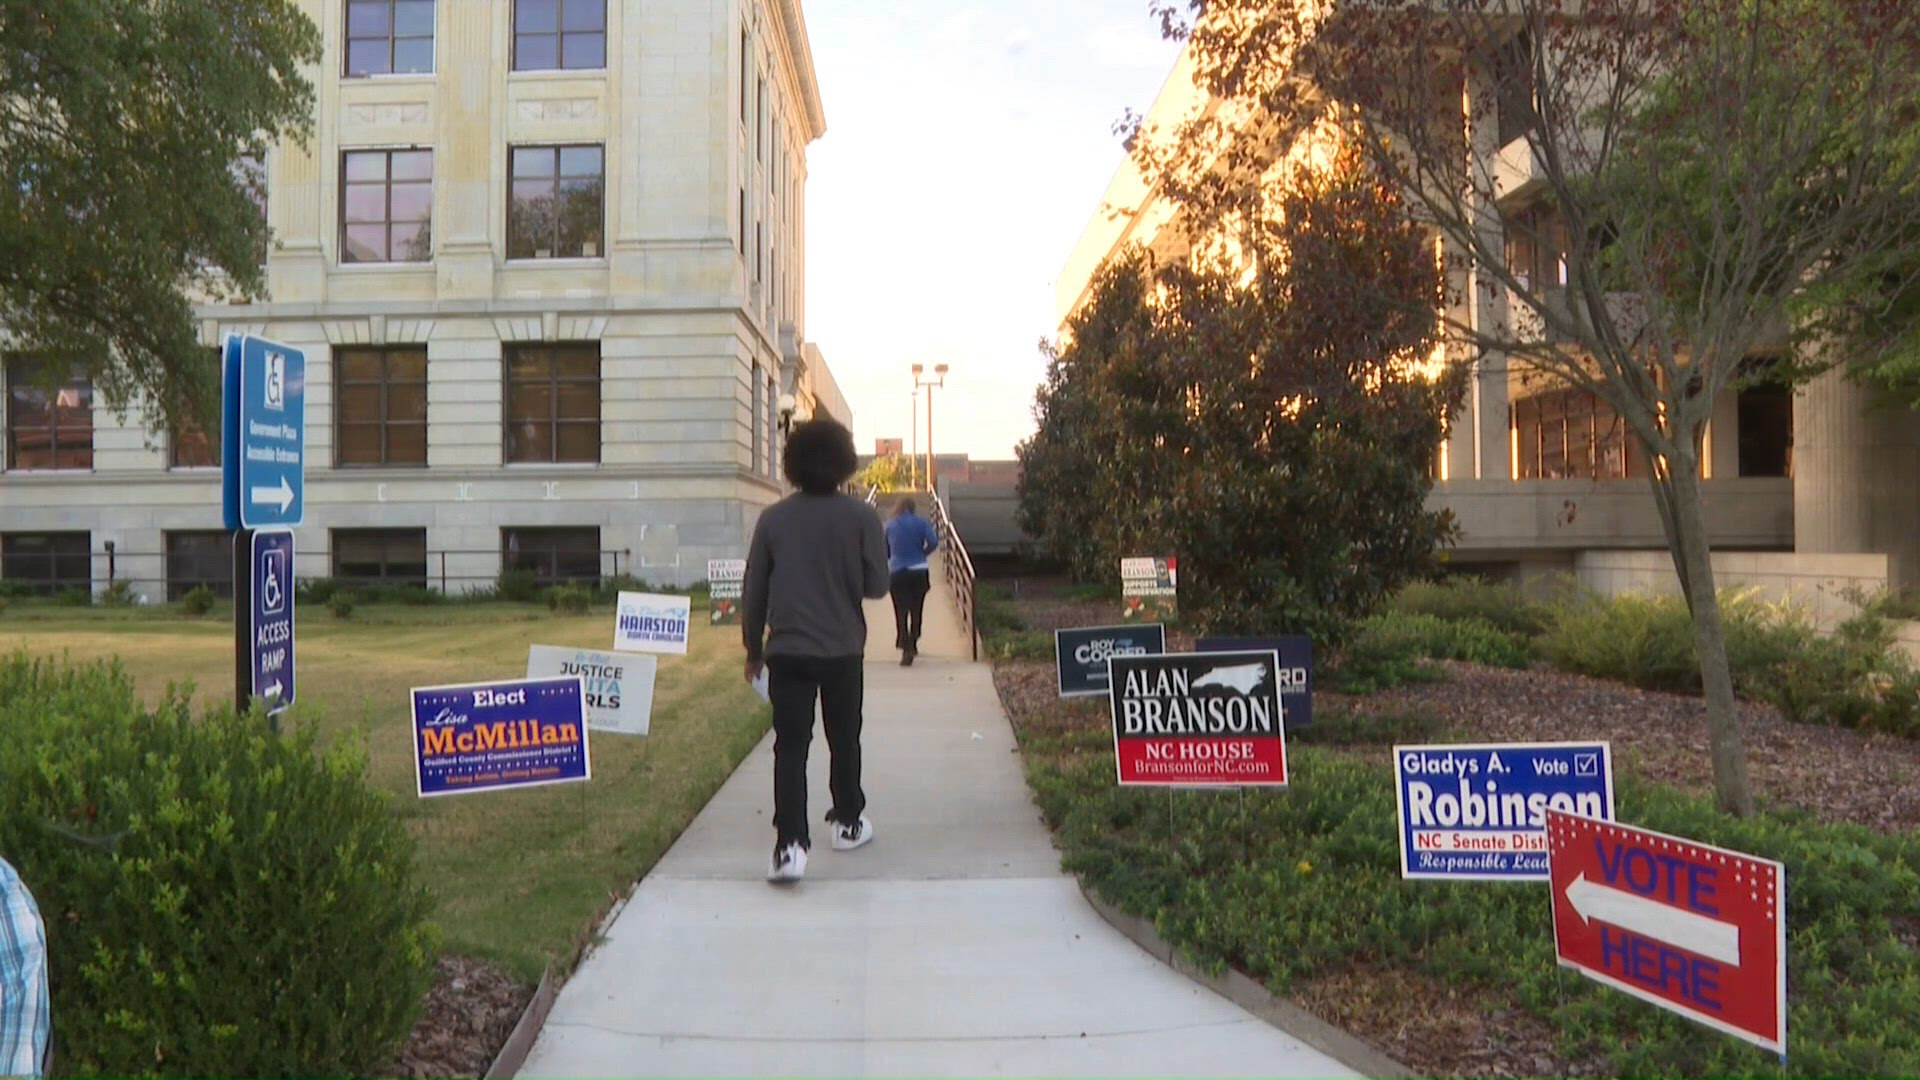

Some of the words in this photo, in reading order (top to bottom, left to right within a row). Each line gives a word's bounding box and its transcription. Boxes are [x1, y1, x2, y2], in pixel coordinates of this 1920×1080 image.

[257, 620, 289, 648] ACCESS
[619, 614, 685, 634] HAIRSTON
[1090, 639, 1115, 650] ROY
[261, 648, 286, 674] RAMP
[560, 661, 624, 680] JUSTICE
[1123, 668, 1189, 697] ALAN
[472, 688, 526, 708] Elect
[584, 693, 621, 709] RLS
[425, 707, 469, 727] Lisa
[1122, 696, 1271, 734] BRANSON
[421, 719, 579, 757] McMillan
[1145, 742, 1175, 760] NC
[1179, 741, 1255, 760] HOUSE
[1135, 758, 1270, 775] BransonforNC.com
[1403, 752, 1479, 779] Gladys
[1486, 751, 1511, 774] A.
[1532, 758, 1569, 775] Vote
[1408, 777, 1601, 827] Robinson
[1417, 833, 1443, 849] NC
[1452, 833, 1506, 849] Senate
[1512, 833, 1547, 849] Dist
[1418, 852, 1508, 873] Responsible
[1594, 838, 1720, 917] VOTE
[1600, 926, 1723, 1011] HERE
